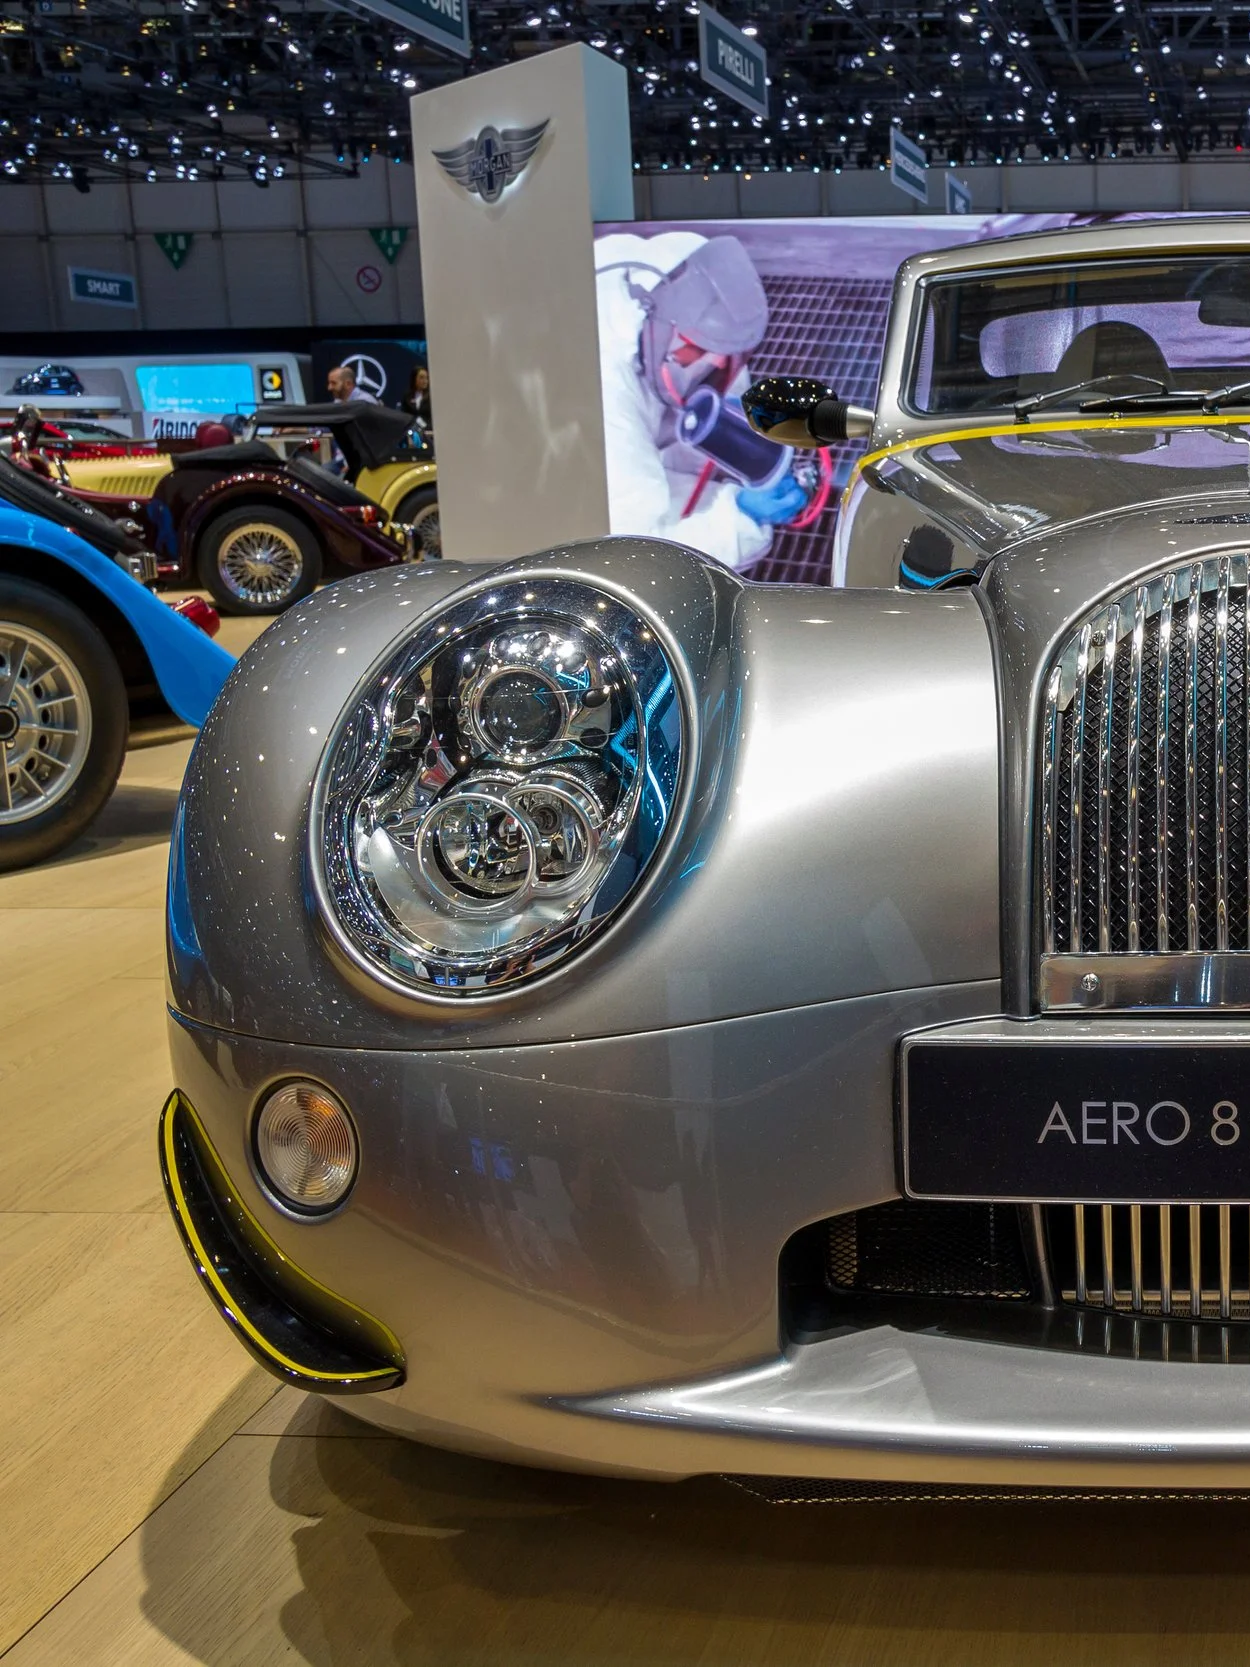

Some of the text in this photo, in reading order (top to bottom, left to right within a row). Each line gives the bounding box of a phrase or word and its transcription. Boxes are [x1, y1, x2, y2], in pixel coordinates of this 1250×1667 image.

[718, 39, 755, 87] PIRELLI
[469, 152, 512, 177] MORGAN
[87, 280, 121, 296] SMART
[1037, 1100, 1192, 1146] AERO
[1211, 1100, 1241, 1146] 8
